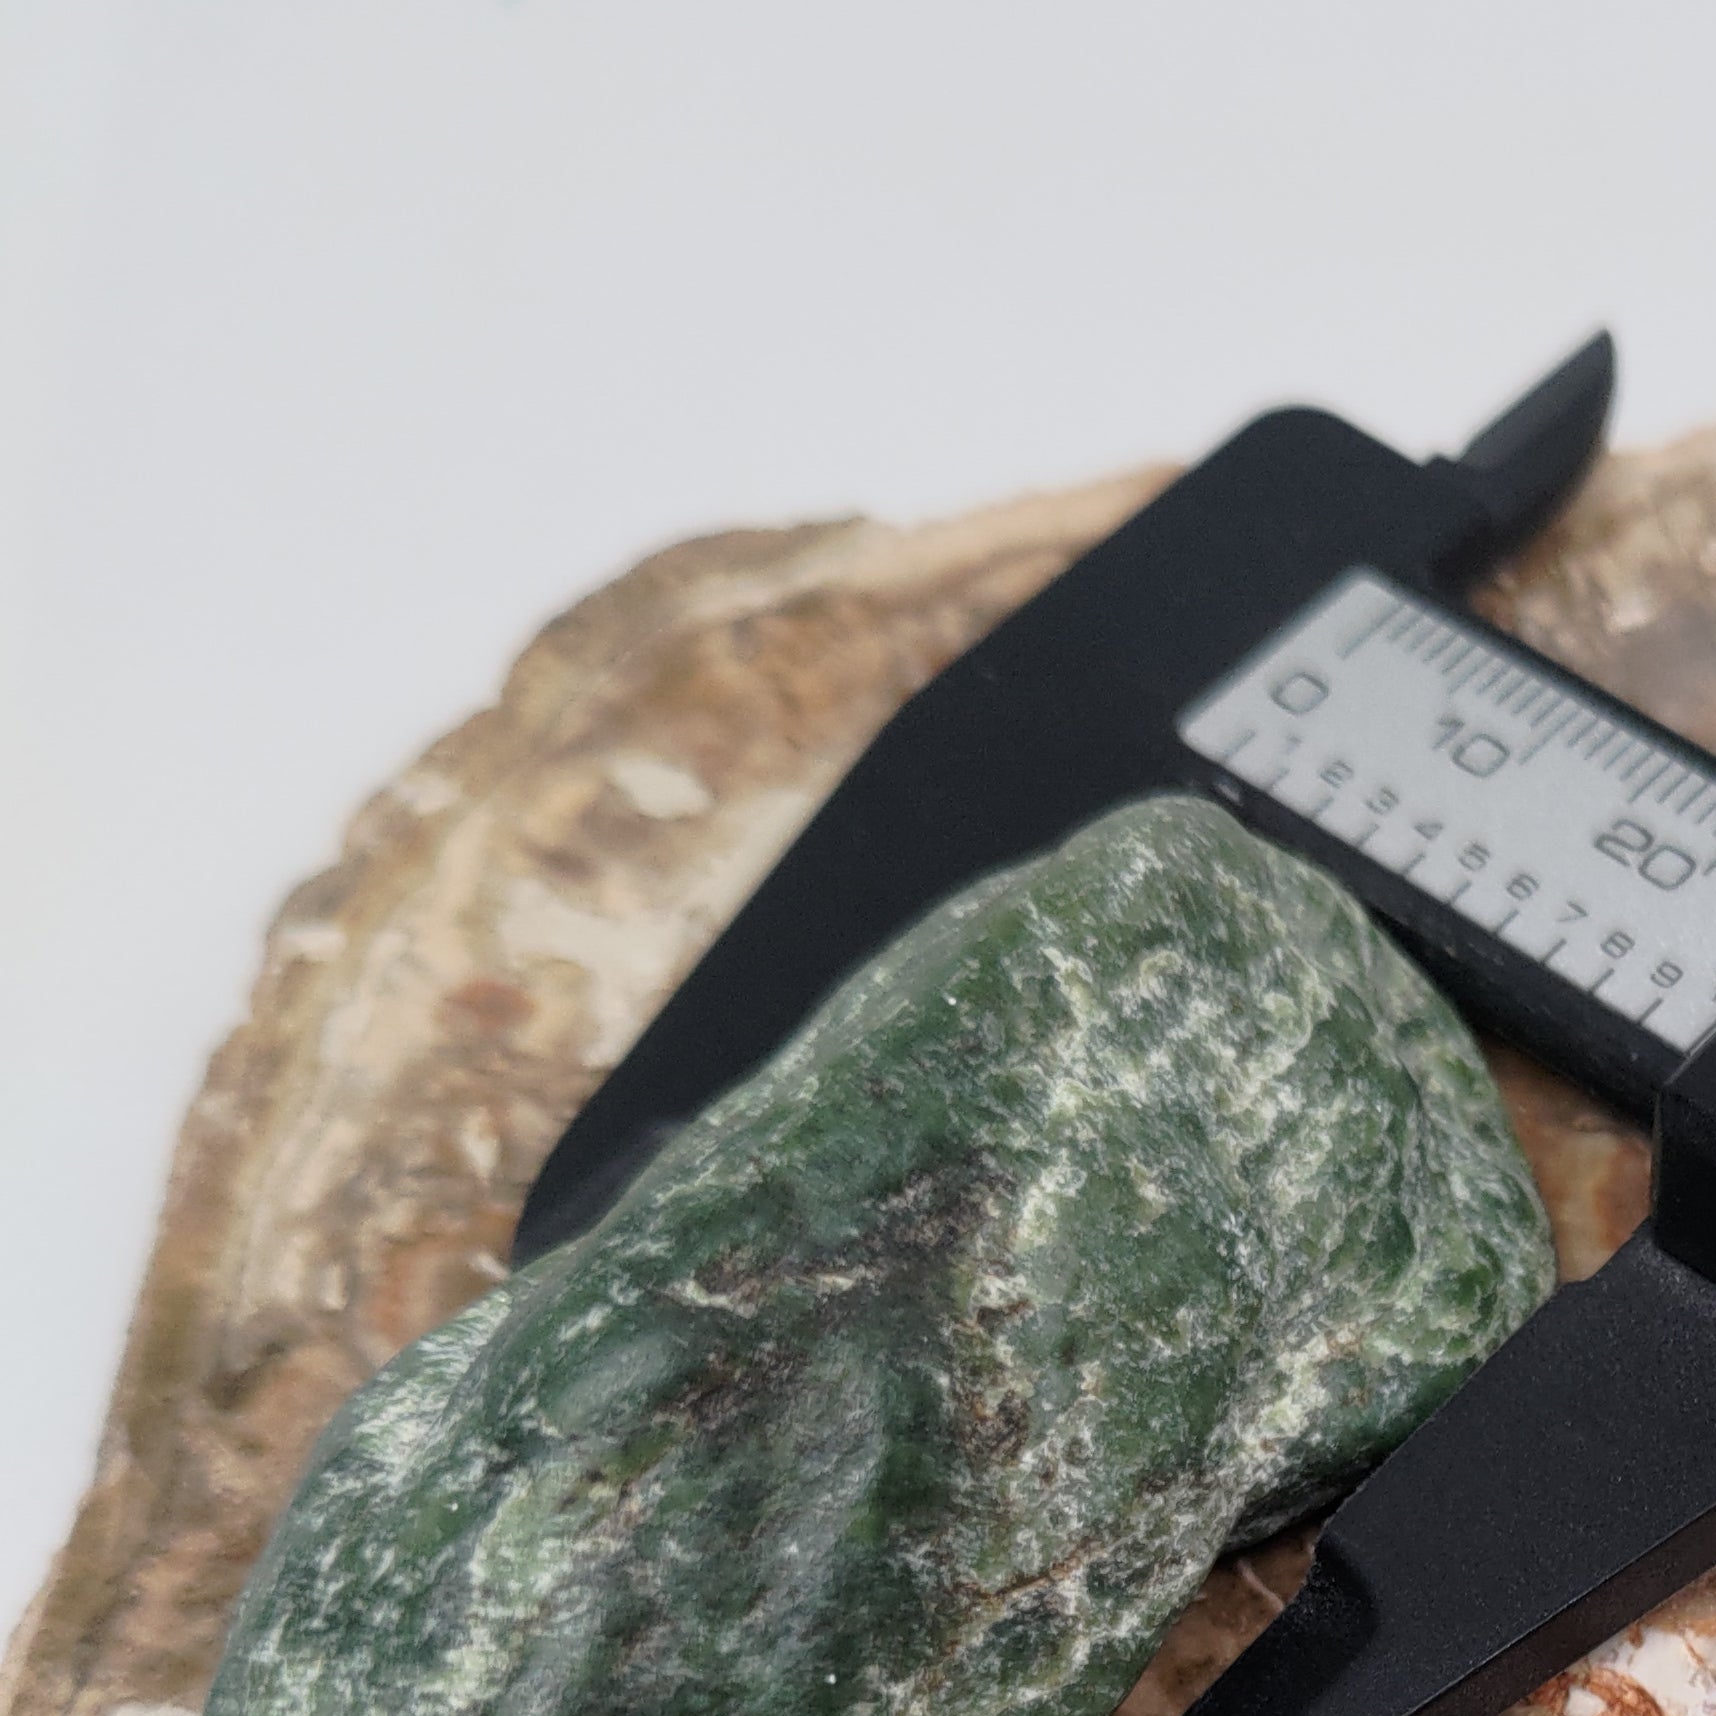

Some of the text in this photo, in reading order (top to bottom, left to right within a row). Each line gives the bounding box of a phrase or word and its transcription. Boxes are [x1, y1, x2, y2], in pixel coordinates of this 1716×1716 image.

[1270, 672, 1697, 892] 0 10 20
[1457, 840, 1491, 872] 5
[1506, 873, 1540, 901] 6
[1556, 900, 1588, 924] 7
[1600, 930, 1636, 960] 8
[1650, 962, 1684, 990] 9
